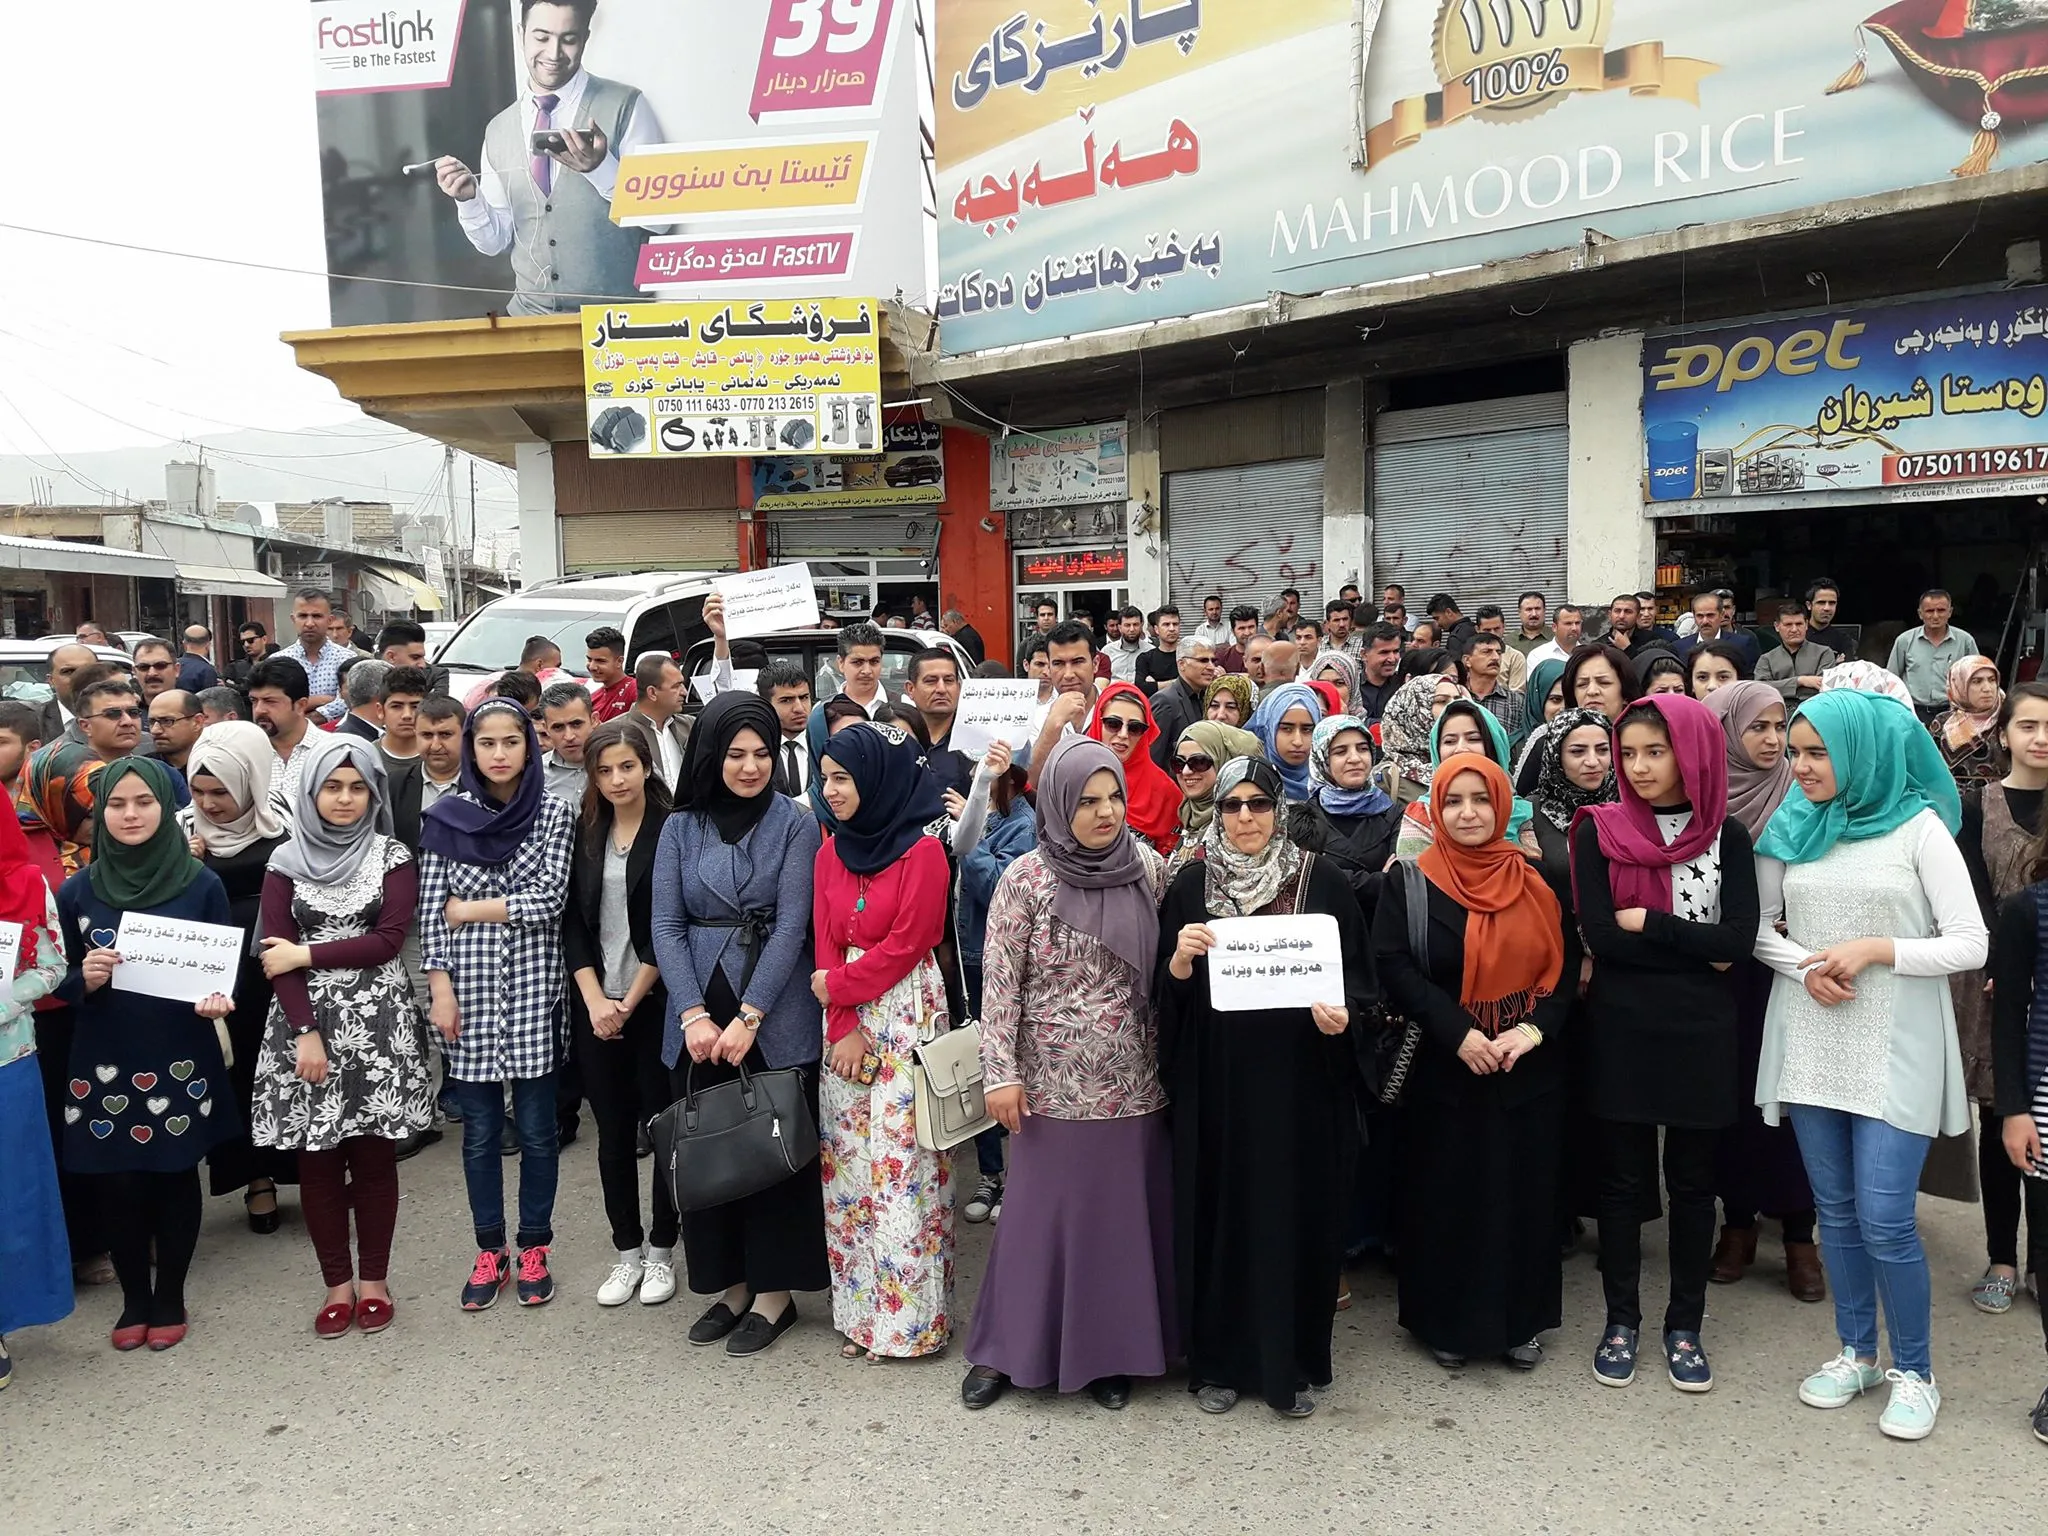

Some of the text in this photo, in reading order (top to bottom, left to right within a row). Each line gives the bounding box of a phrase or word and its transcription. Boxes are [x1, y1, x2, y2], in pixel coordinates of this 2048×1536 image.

[772, 0, 880, 57] 39
[353, 50, 436, 68] Be The Fastest
[763, 69, 866, 97] هەزار دینار
[1464, 48, 1569, 105] 100%
[732, 163, 773, 193] بێ
[779, 154, 853, 189] ئێستا
[1270, 105, 1805, 258] MAHMOOD RICE
[772, 241, 841, 267] FastTV
[591, 304, 870, 347] فرۆشگای ستار
[1987, 320, 1999, 345] و
[658, 399, 682, 412] 0750
[686, 399, 702, 412] 111
[706, 398, 730, 411] 6433
[740, 397, 765, 410] 0770
[768, 396, 787, 410] 213
[789, 396, 814, 409] 2615
[1818, 376, 1934, 435] شیروان
[1898, 447, 2048, 478] 07501119617
